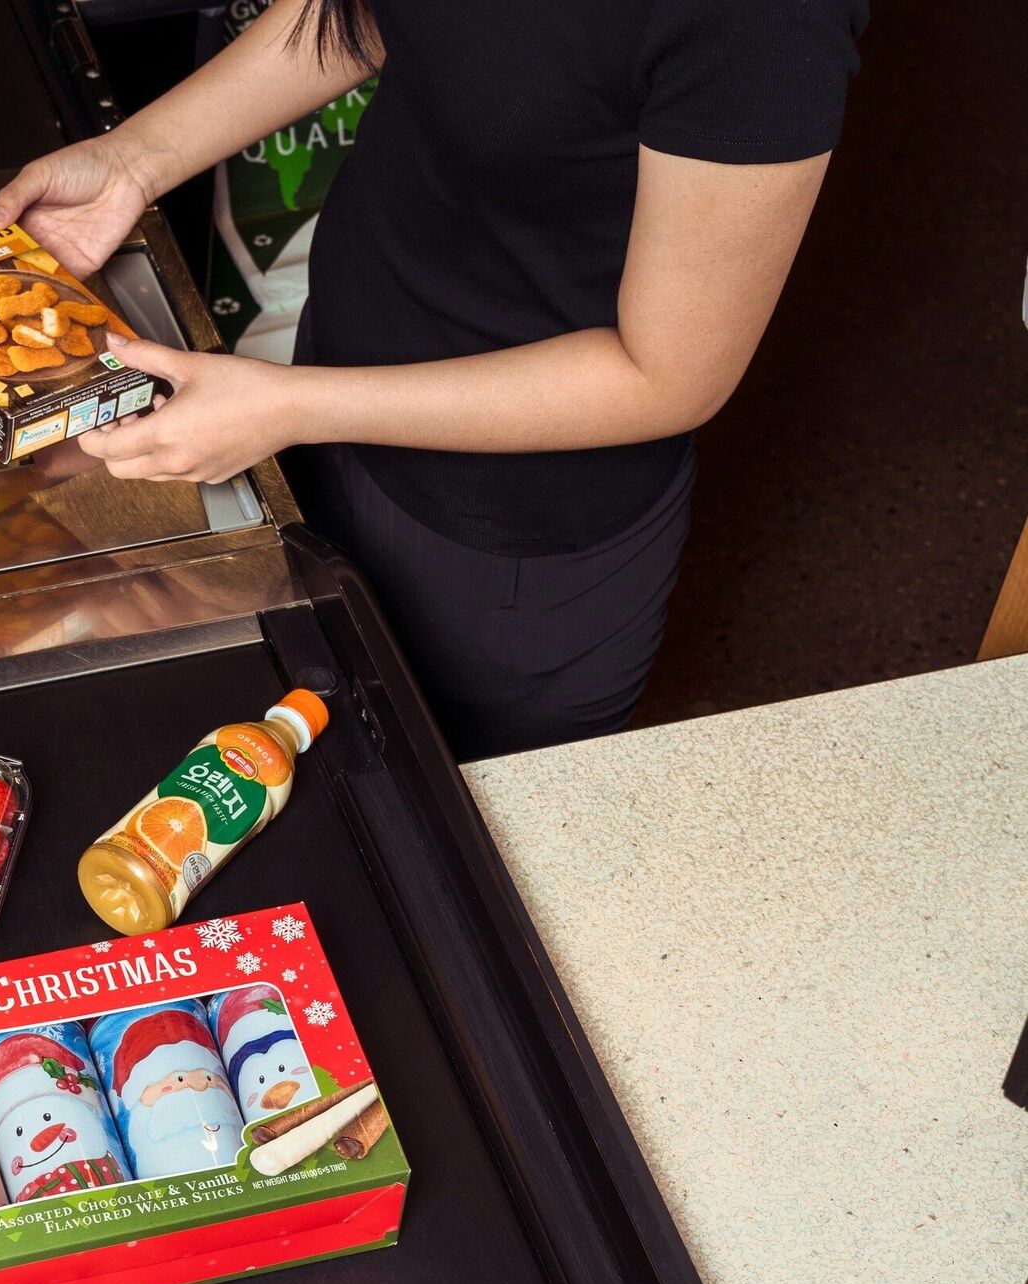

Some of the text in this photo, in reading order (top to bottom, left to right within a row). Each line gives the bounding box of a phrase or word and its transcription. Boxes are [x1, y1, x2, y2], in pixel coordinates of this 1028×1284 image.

[236, 733, 275, 766] ORANGE
[180, 759, 248, 821] 오렌지
[77, 1189, 163, 1214] CHOCOLATE
[168, 1183, 181, 1196] &
[185, 1173, 240, 1193] Vanilla
[252, 1181, 265, 1190] NET
[265, 1176, 289, 1189] WEIGHT
[44, 1184, 244, 1235] FLAVOURED WAFER STICKS
